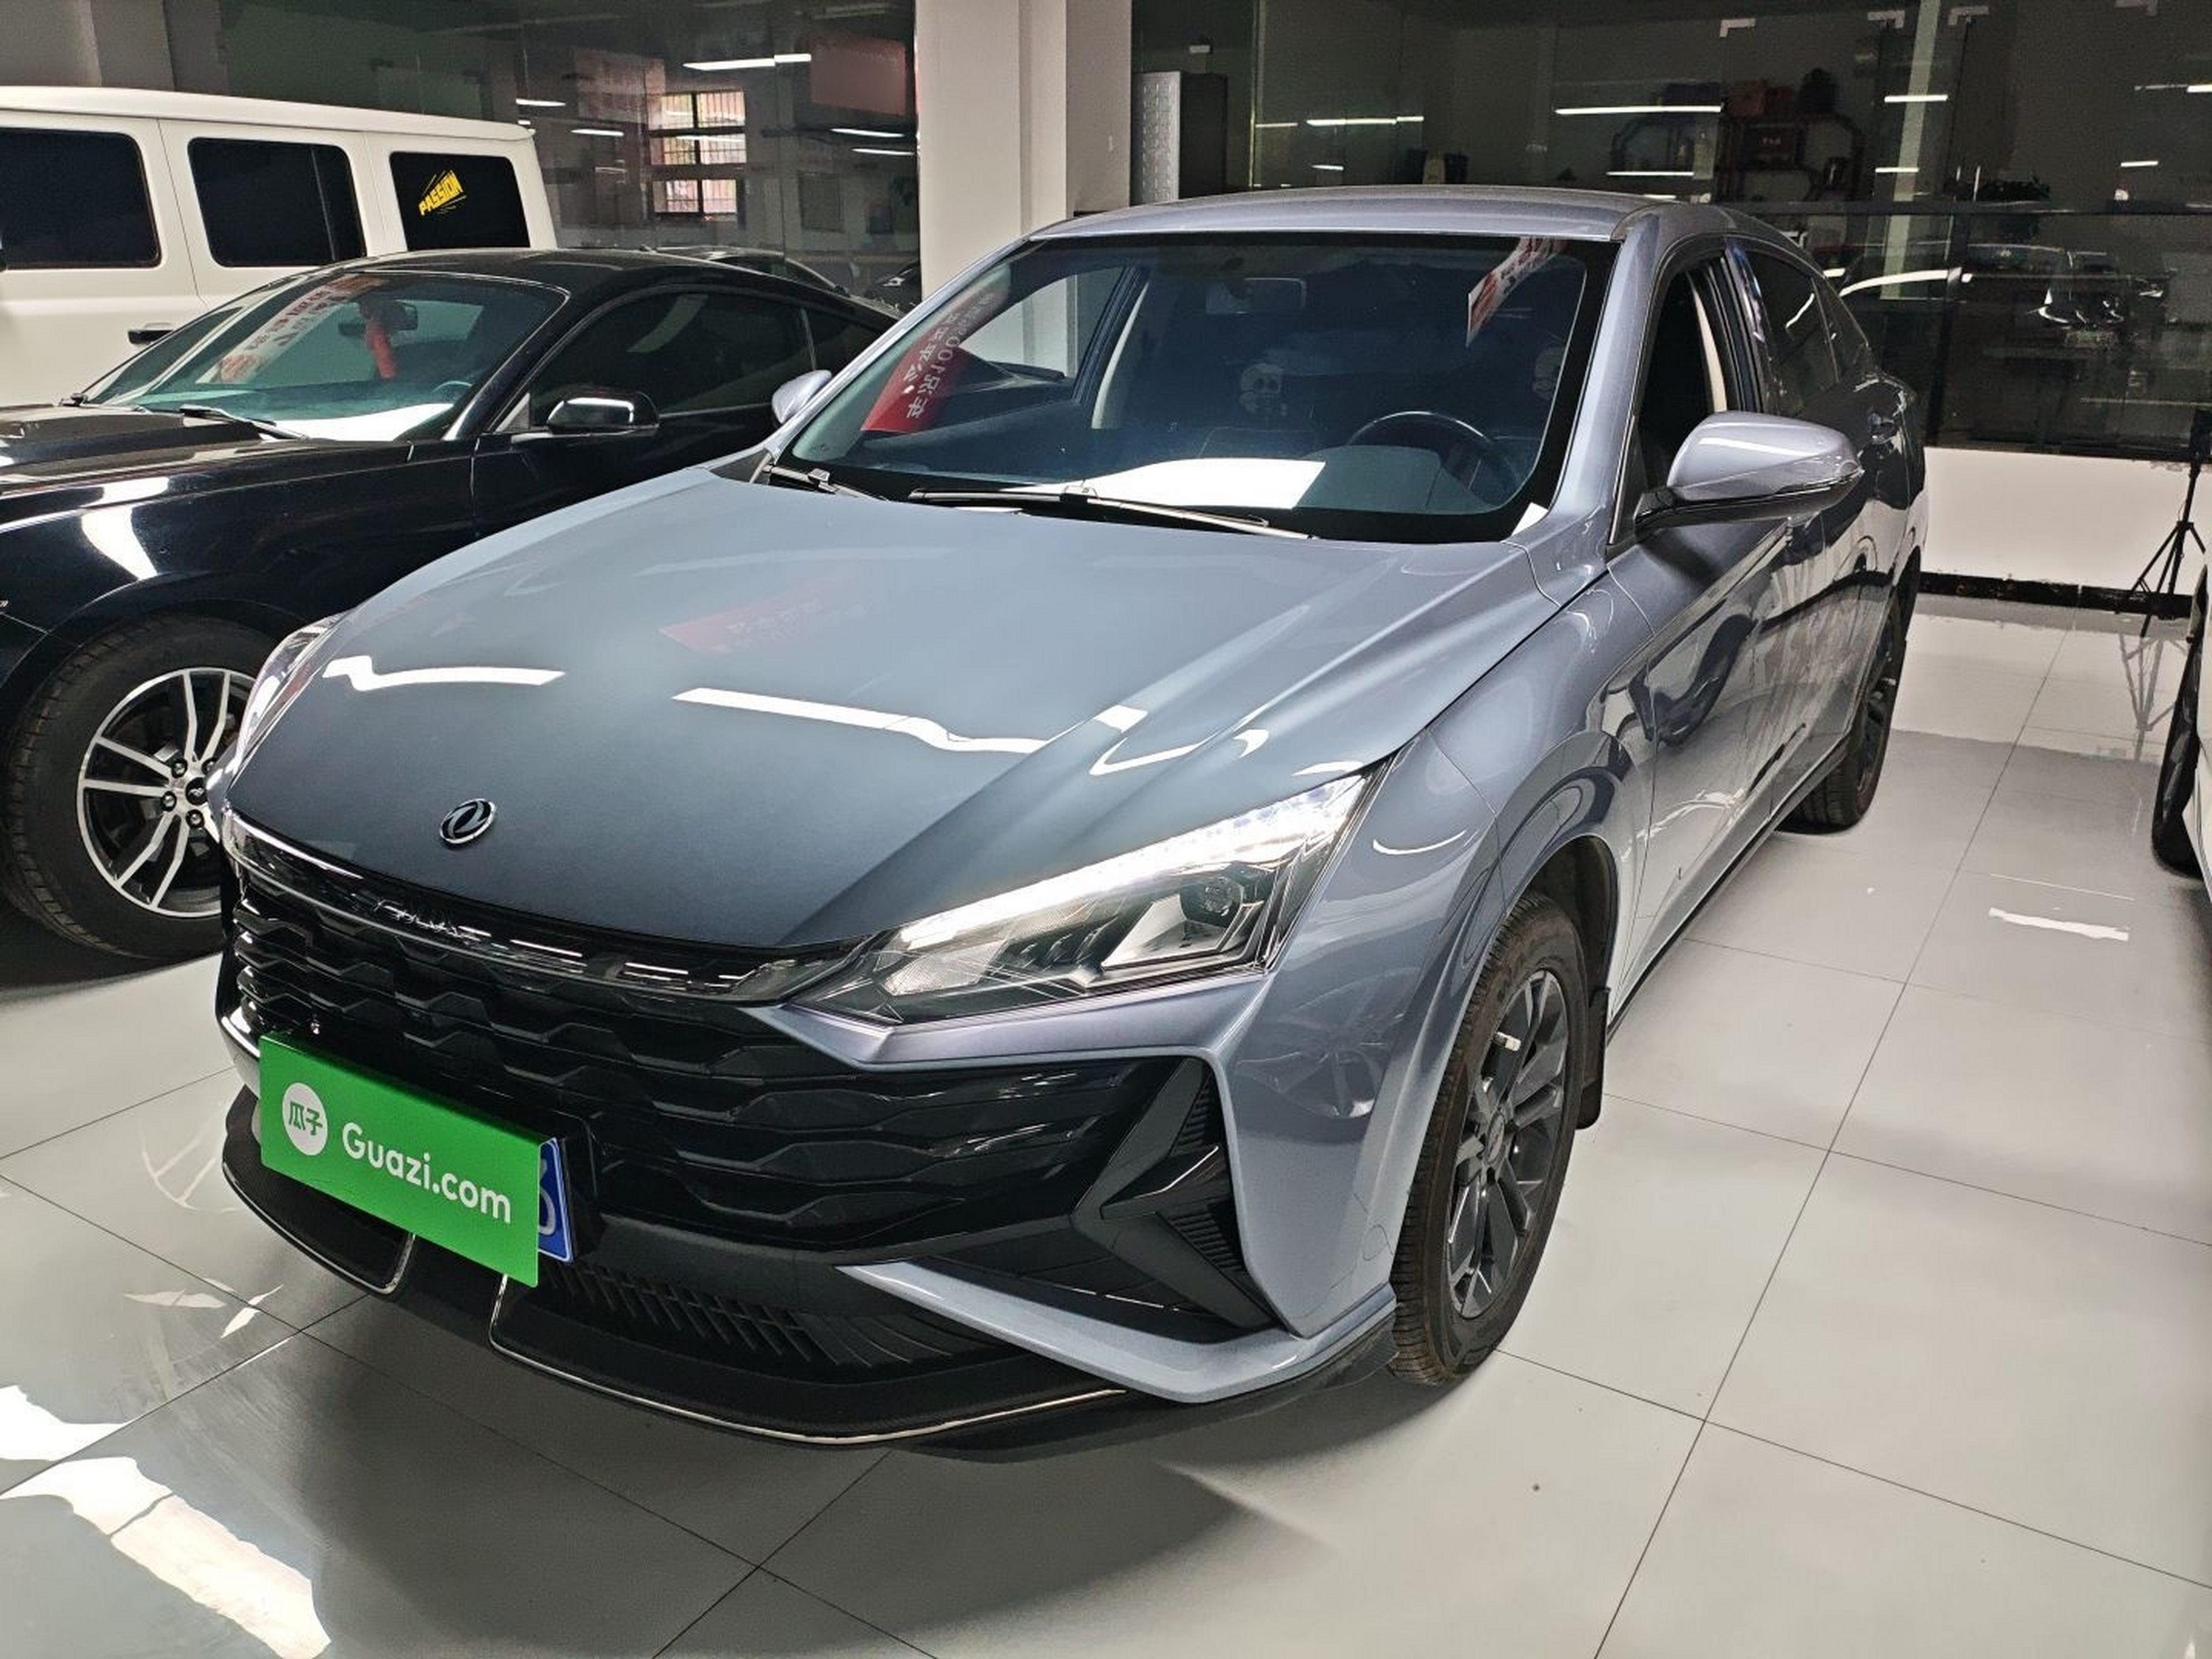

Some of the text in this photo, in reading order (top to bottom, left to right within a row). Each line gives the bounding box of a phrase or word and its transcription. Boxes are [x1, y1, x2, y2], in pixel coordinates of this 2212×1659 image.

[419, 170, 464, 215] PASSION
[289, 1101, 323, 1136] 瓜子
[342, 1122, 511, 1224] Guazi.com
